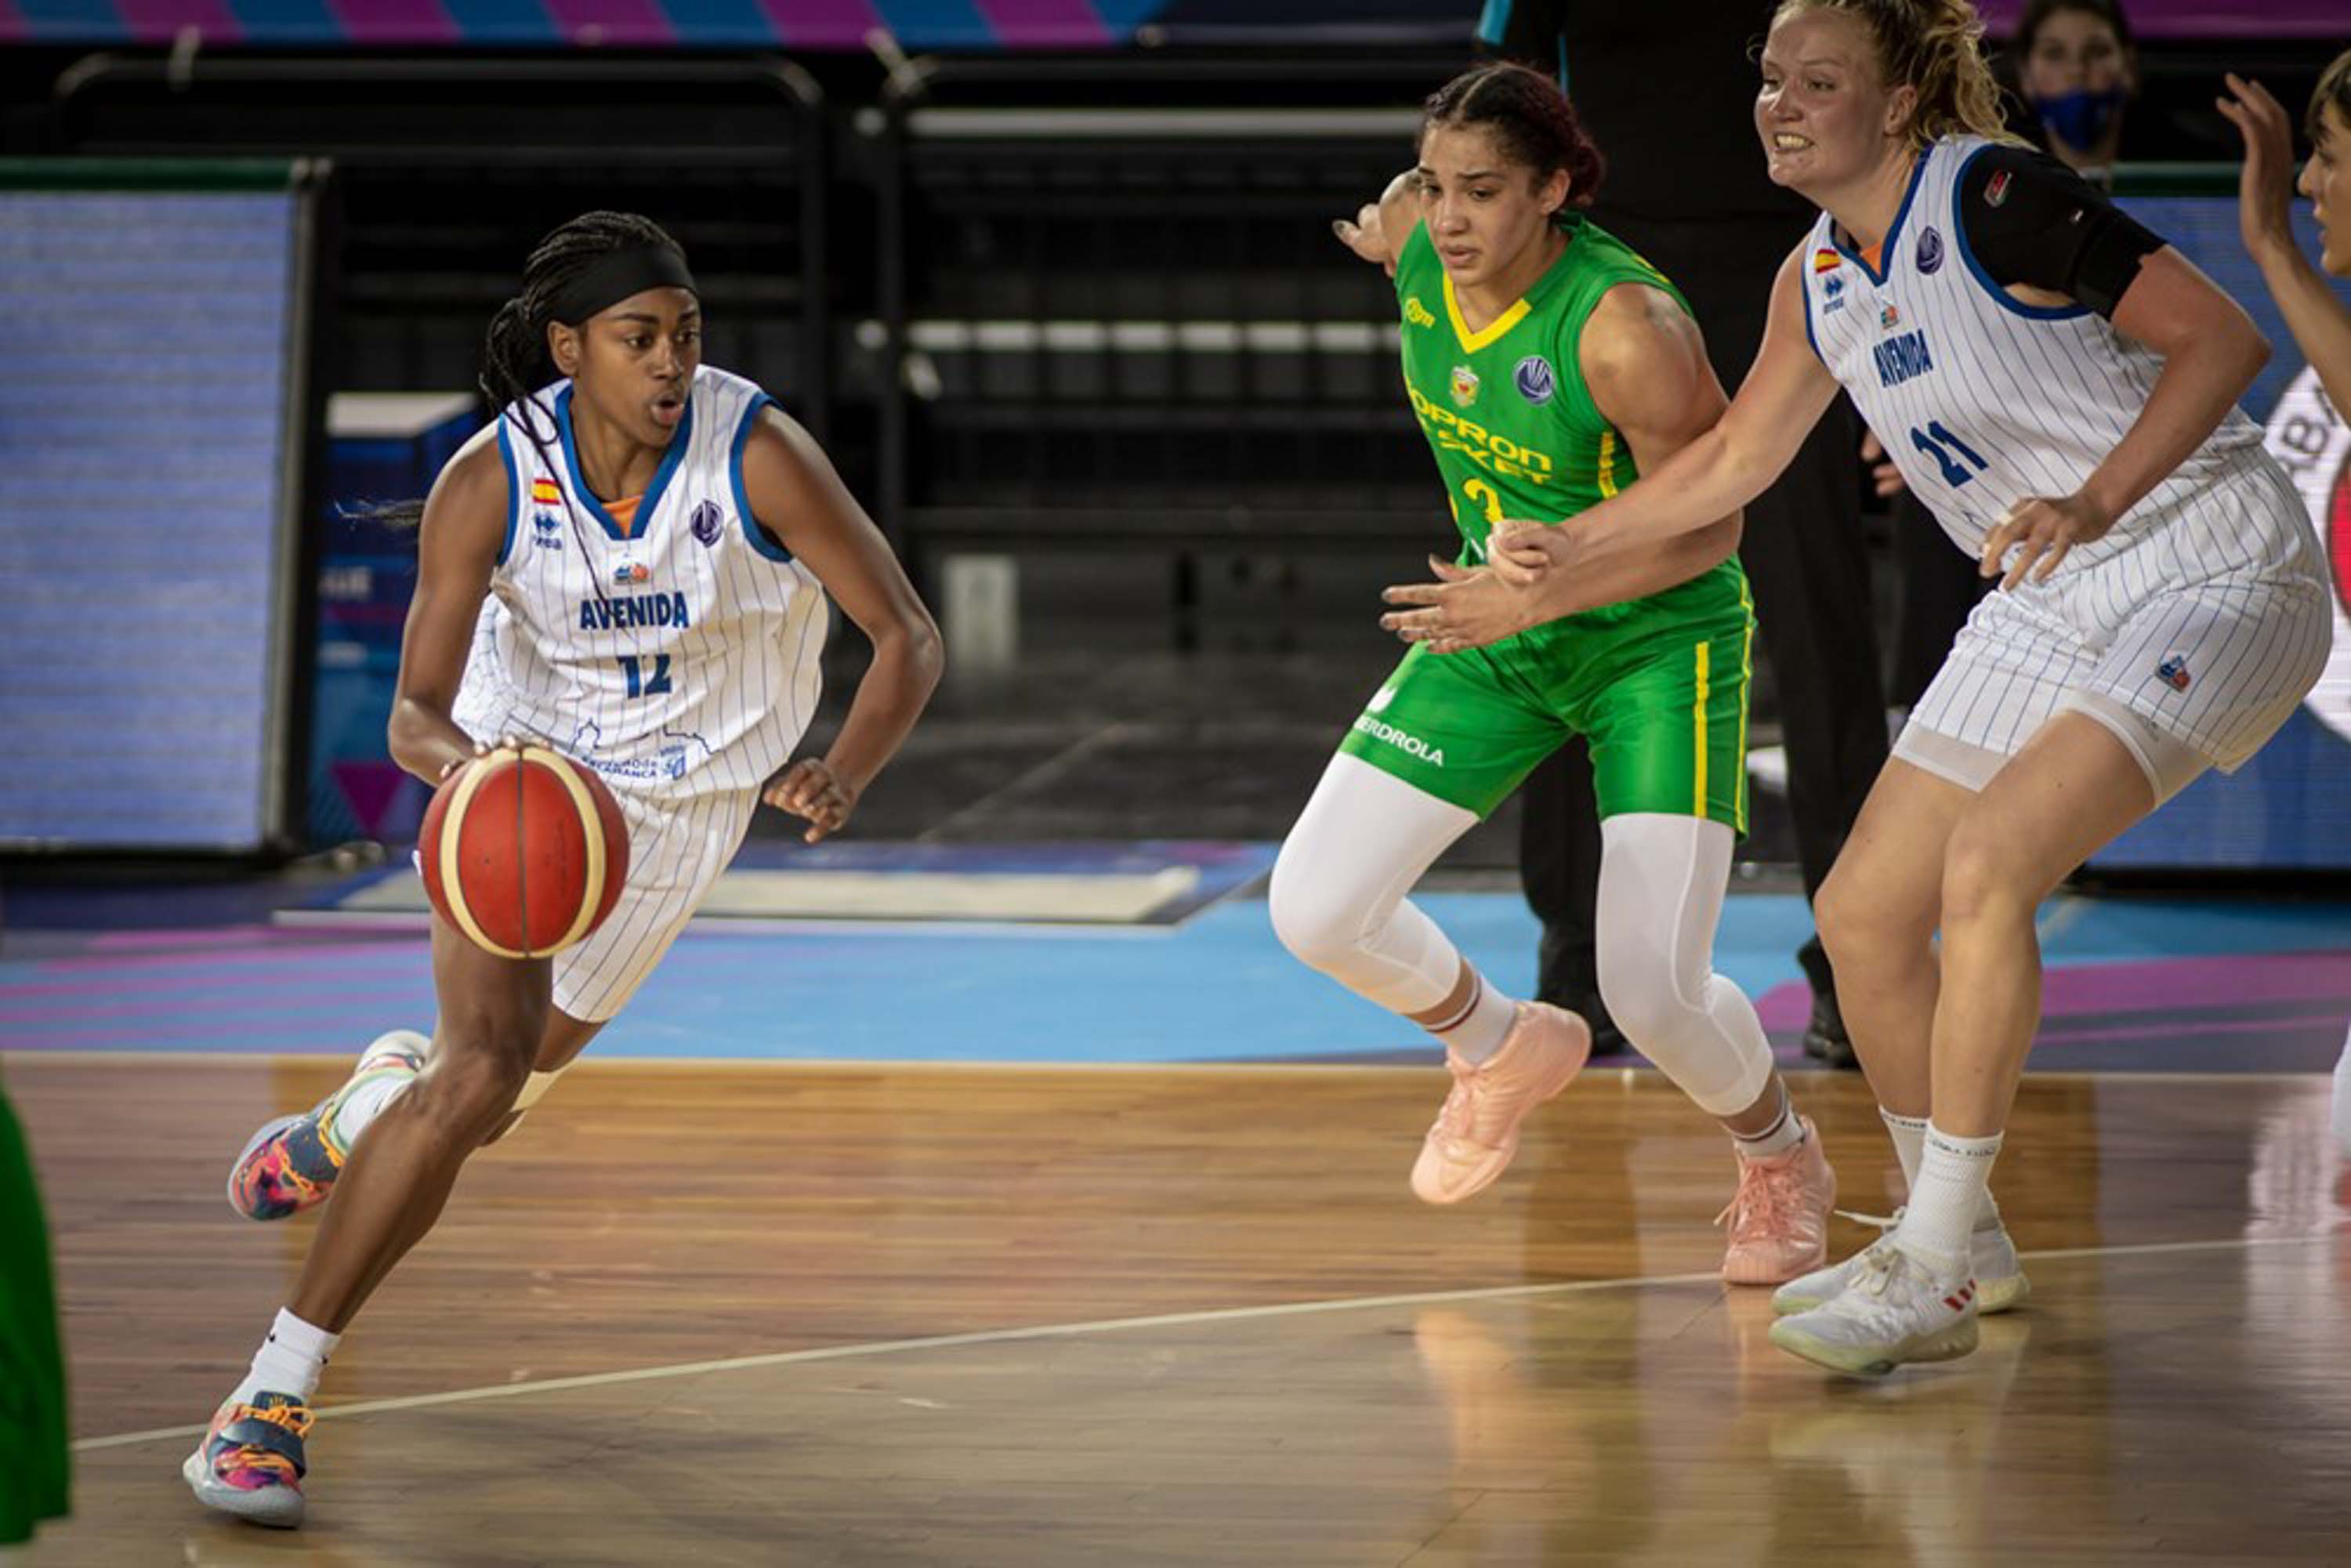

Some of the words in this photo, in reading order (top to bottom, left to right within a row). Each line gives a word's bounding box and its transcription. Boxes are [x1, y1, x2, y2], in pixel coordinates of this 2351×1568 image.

[1873, 328, 1933, 388] AVENIDA
[1409, 389, 1552, 472] OPRON
[1910, 419, 1989, 488] 21
[580, 591, 690, 630] AVENIDA
[616, 653, 672, 700] 12
